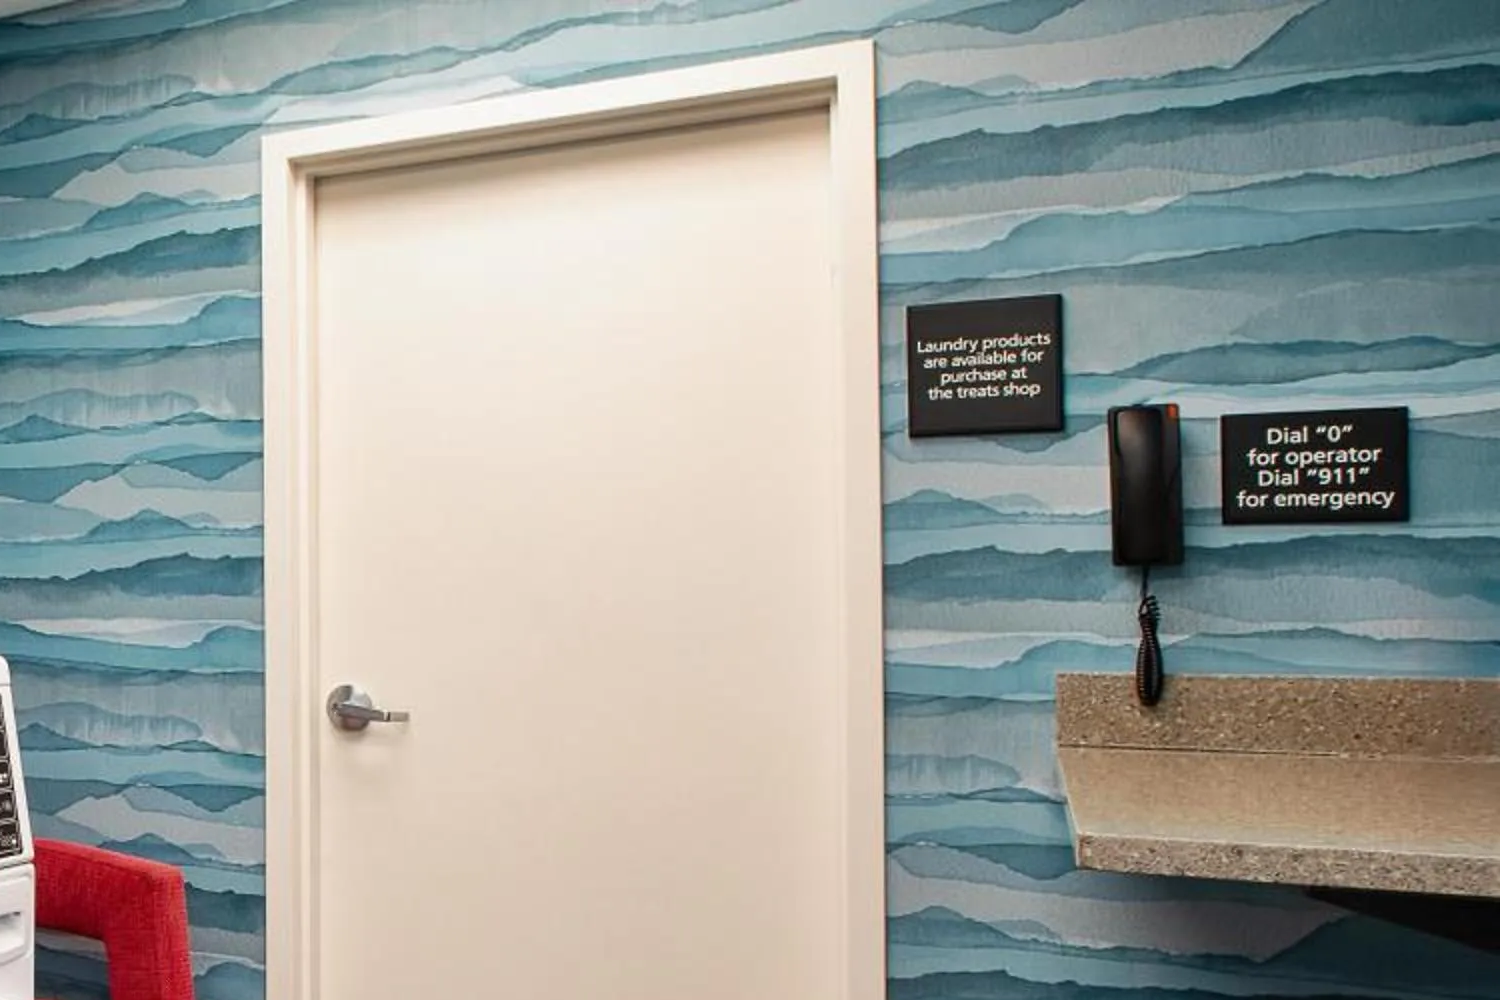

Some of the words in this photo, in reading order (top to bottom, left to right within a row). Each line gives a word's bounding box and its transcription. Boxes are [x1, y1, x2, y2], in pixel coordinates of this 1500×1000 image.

[917, 337, 978, 353] Laundry
[982, 332, 1051, 351] products
[923, 357, 947, 369] are
[951, 350, 1017, 367] available
[1021, 348, 1044, 362] for
[940, 367, 1007, 386] purchase
[1011, 367, 1028, 379] at
[928, 386, 953, 400] the
[956, 385, 1000, 398] treats
[1003, 382, 1041, 397] shop
[1267, 425, 1309, 444] Dial
[1246, 448, 1280, 466] for
[1285, 447, 1383, 468] operator
[1257, 469, 1299, 487] Dial
[1236, 489, 1269, 508] for
[1274, 490, 1396, 511] emergency
